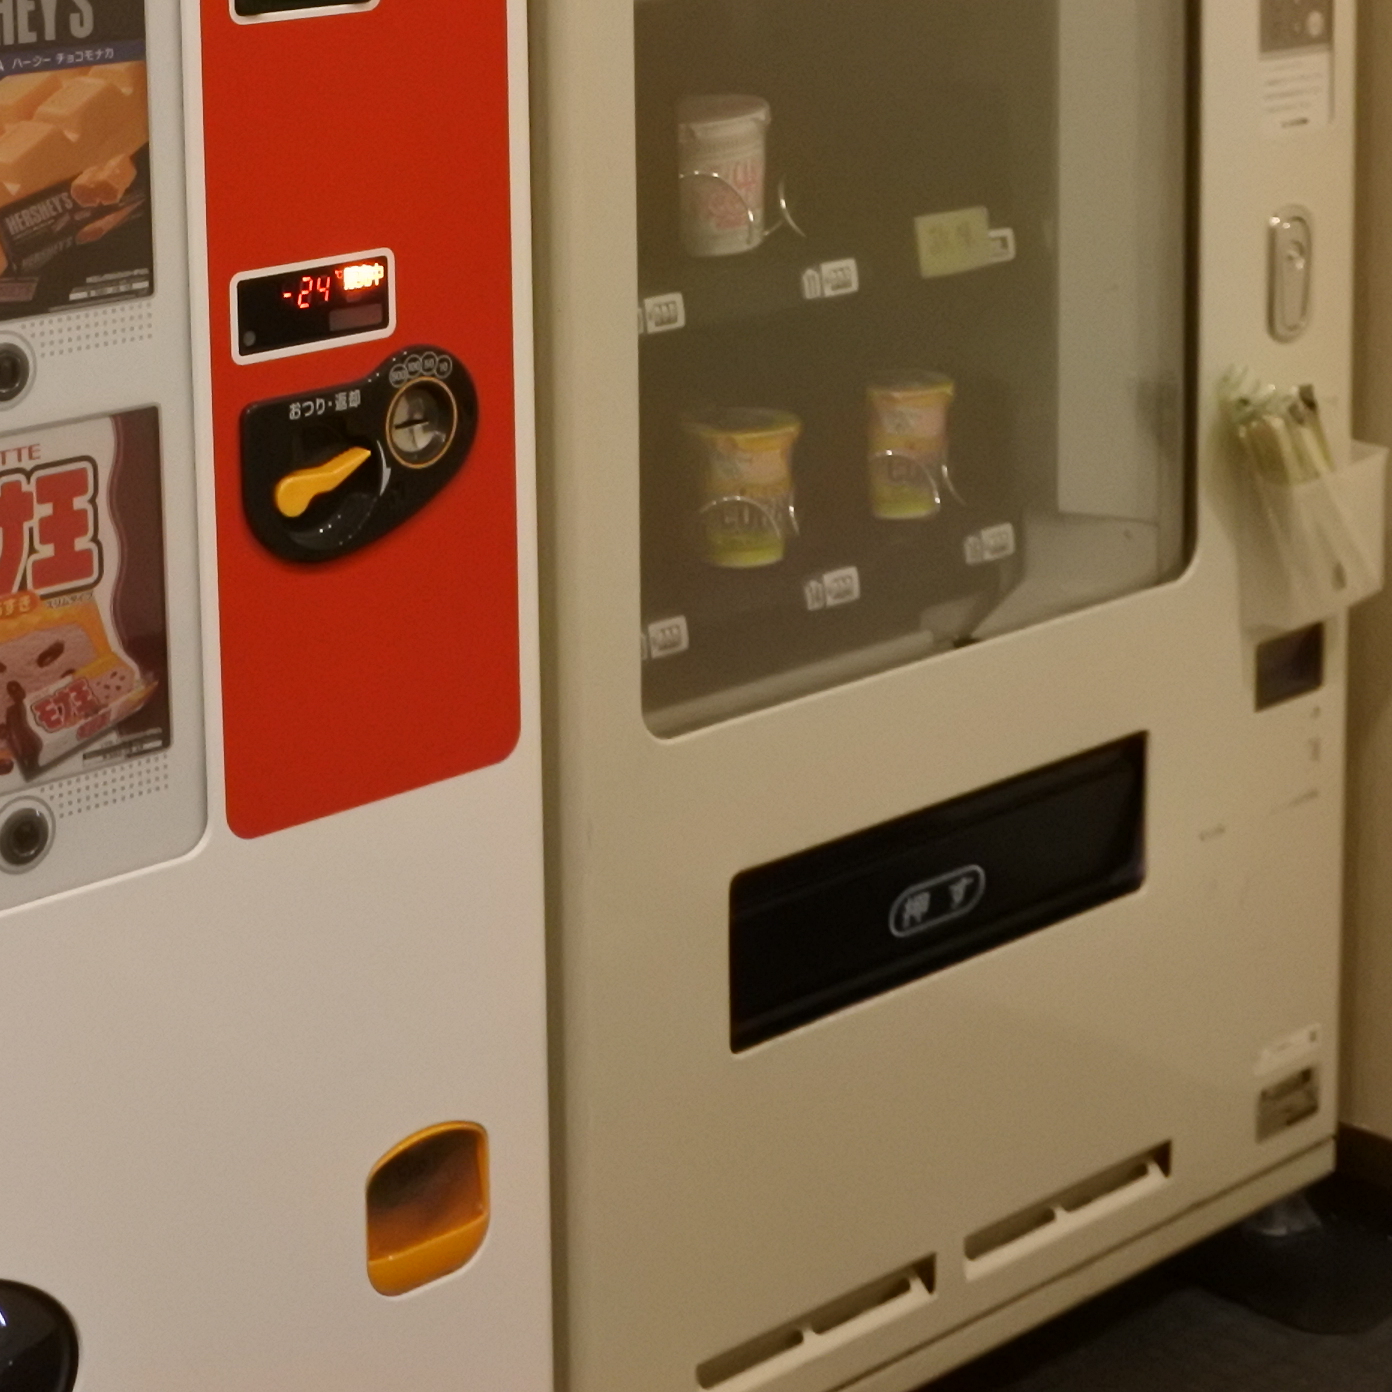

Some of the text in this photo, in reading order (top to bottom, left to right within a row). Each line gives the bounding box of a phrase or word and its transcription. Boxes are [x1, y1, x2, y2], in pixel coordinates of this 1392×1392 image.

[55, 47, 115, 65] チョコモナカ
[3, 190, 75, 236] HERSHEY'S
[289, 389, 362, 421] おつり・返却
[32, 678, 101, 733] モナ王
